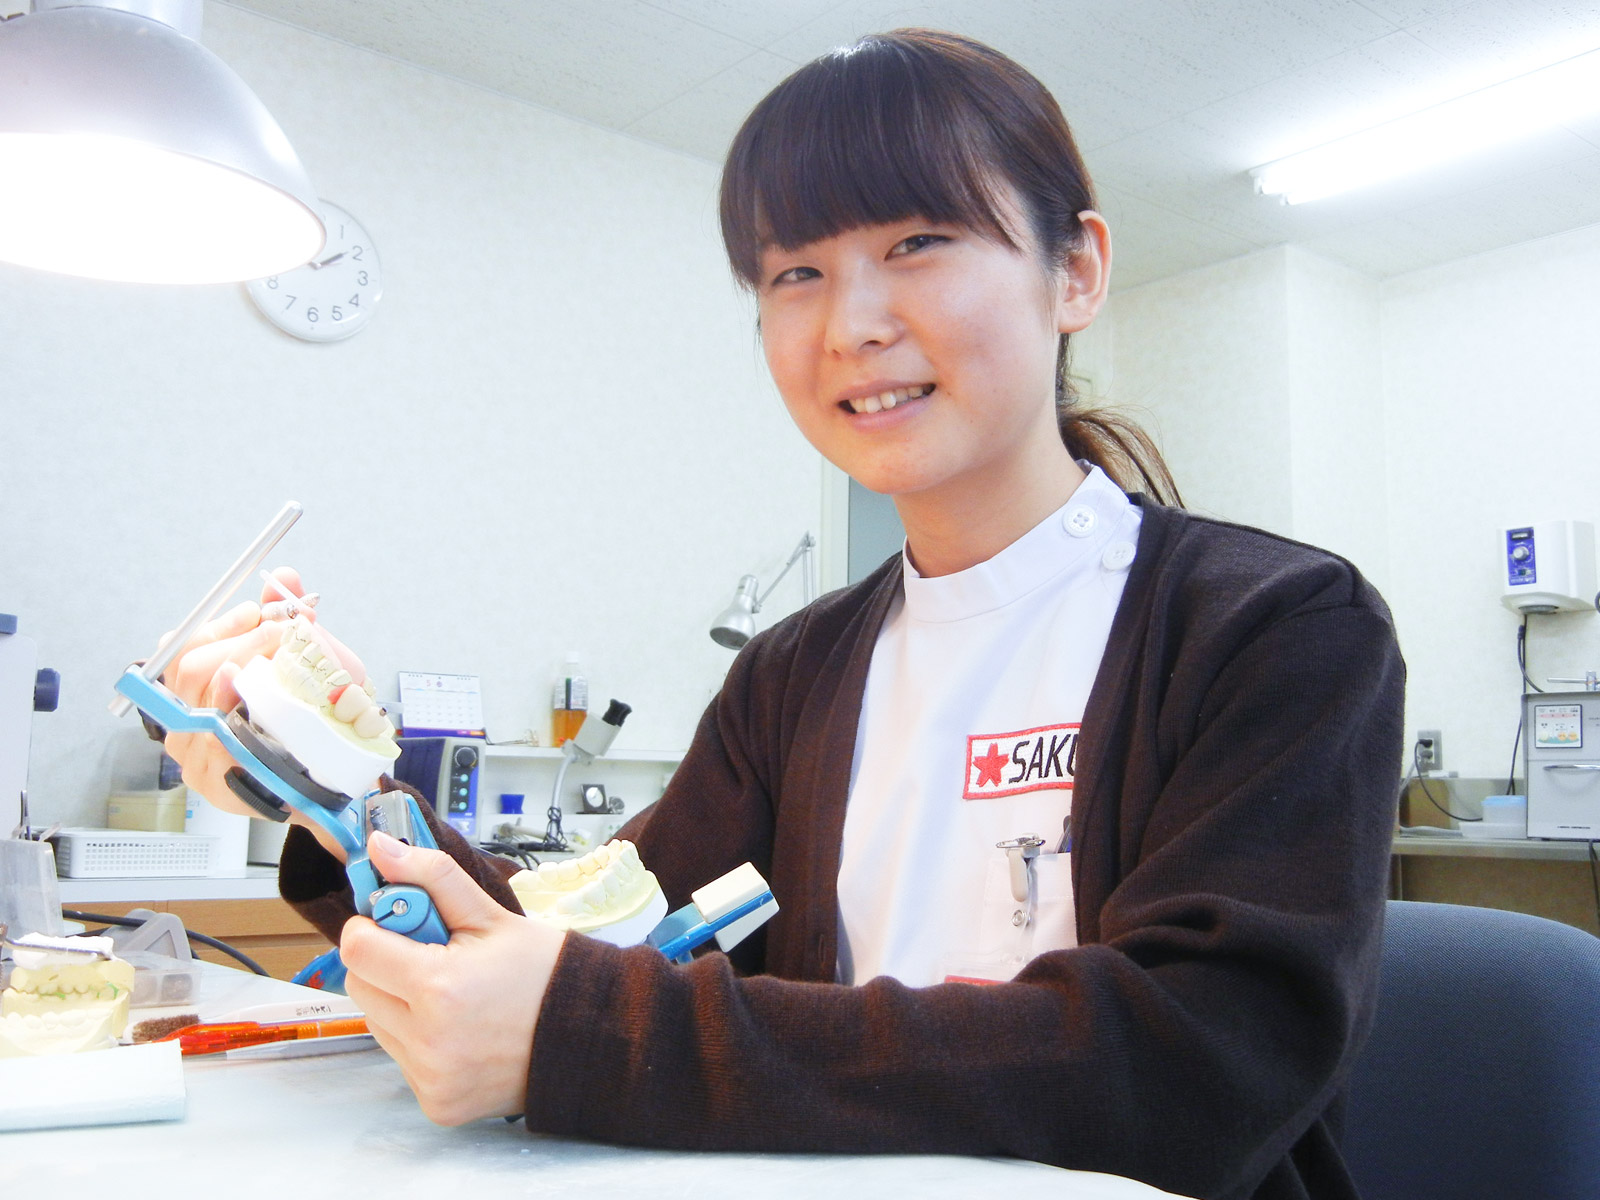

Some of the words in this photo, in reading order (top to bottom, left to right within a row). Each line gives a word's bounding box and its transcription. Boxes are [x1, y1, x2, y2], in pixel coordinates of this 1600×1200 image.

[340, 224, 344, 239] 1
[352, 245, 363, 261] 2
[357, 270, 368, 286] 3
[285, 294, 297, 310] 7
[348, 293, 359, 307] 4
[307, 307, 319, 322] 6
[331, 305, 343, 321] 5
